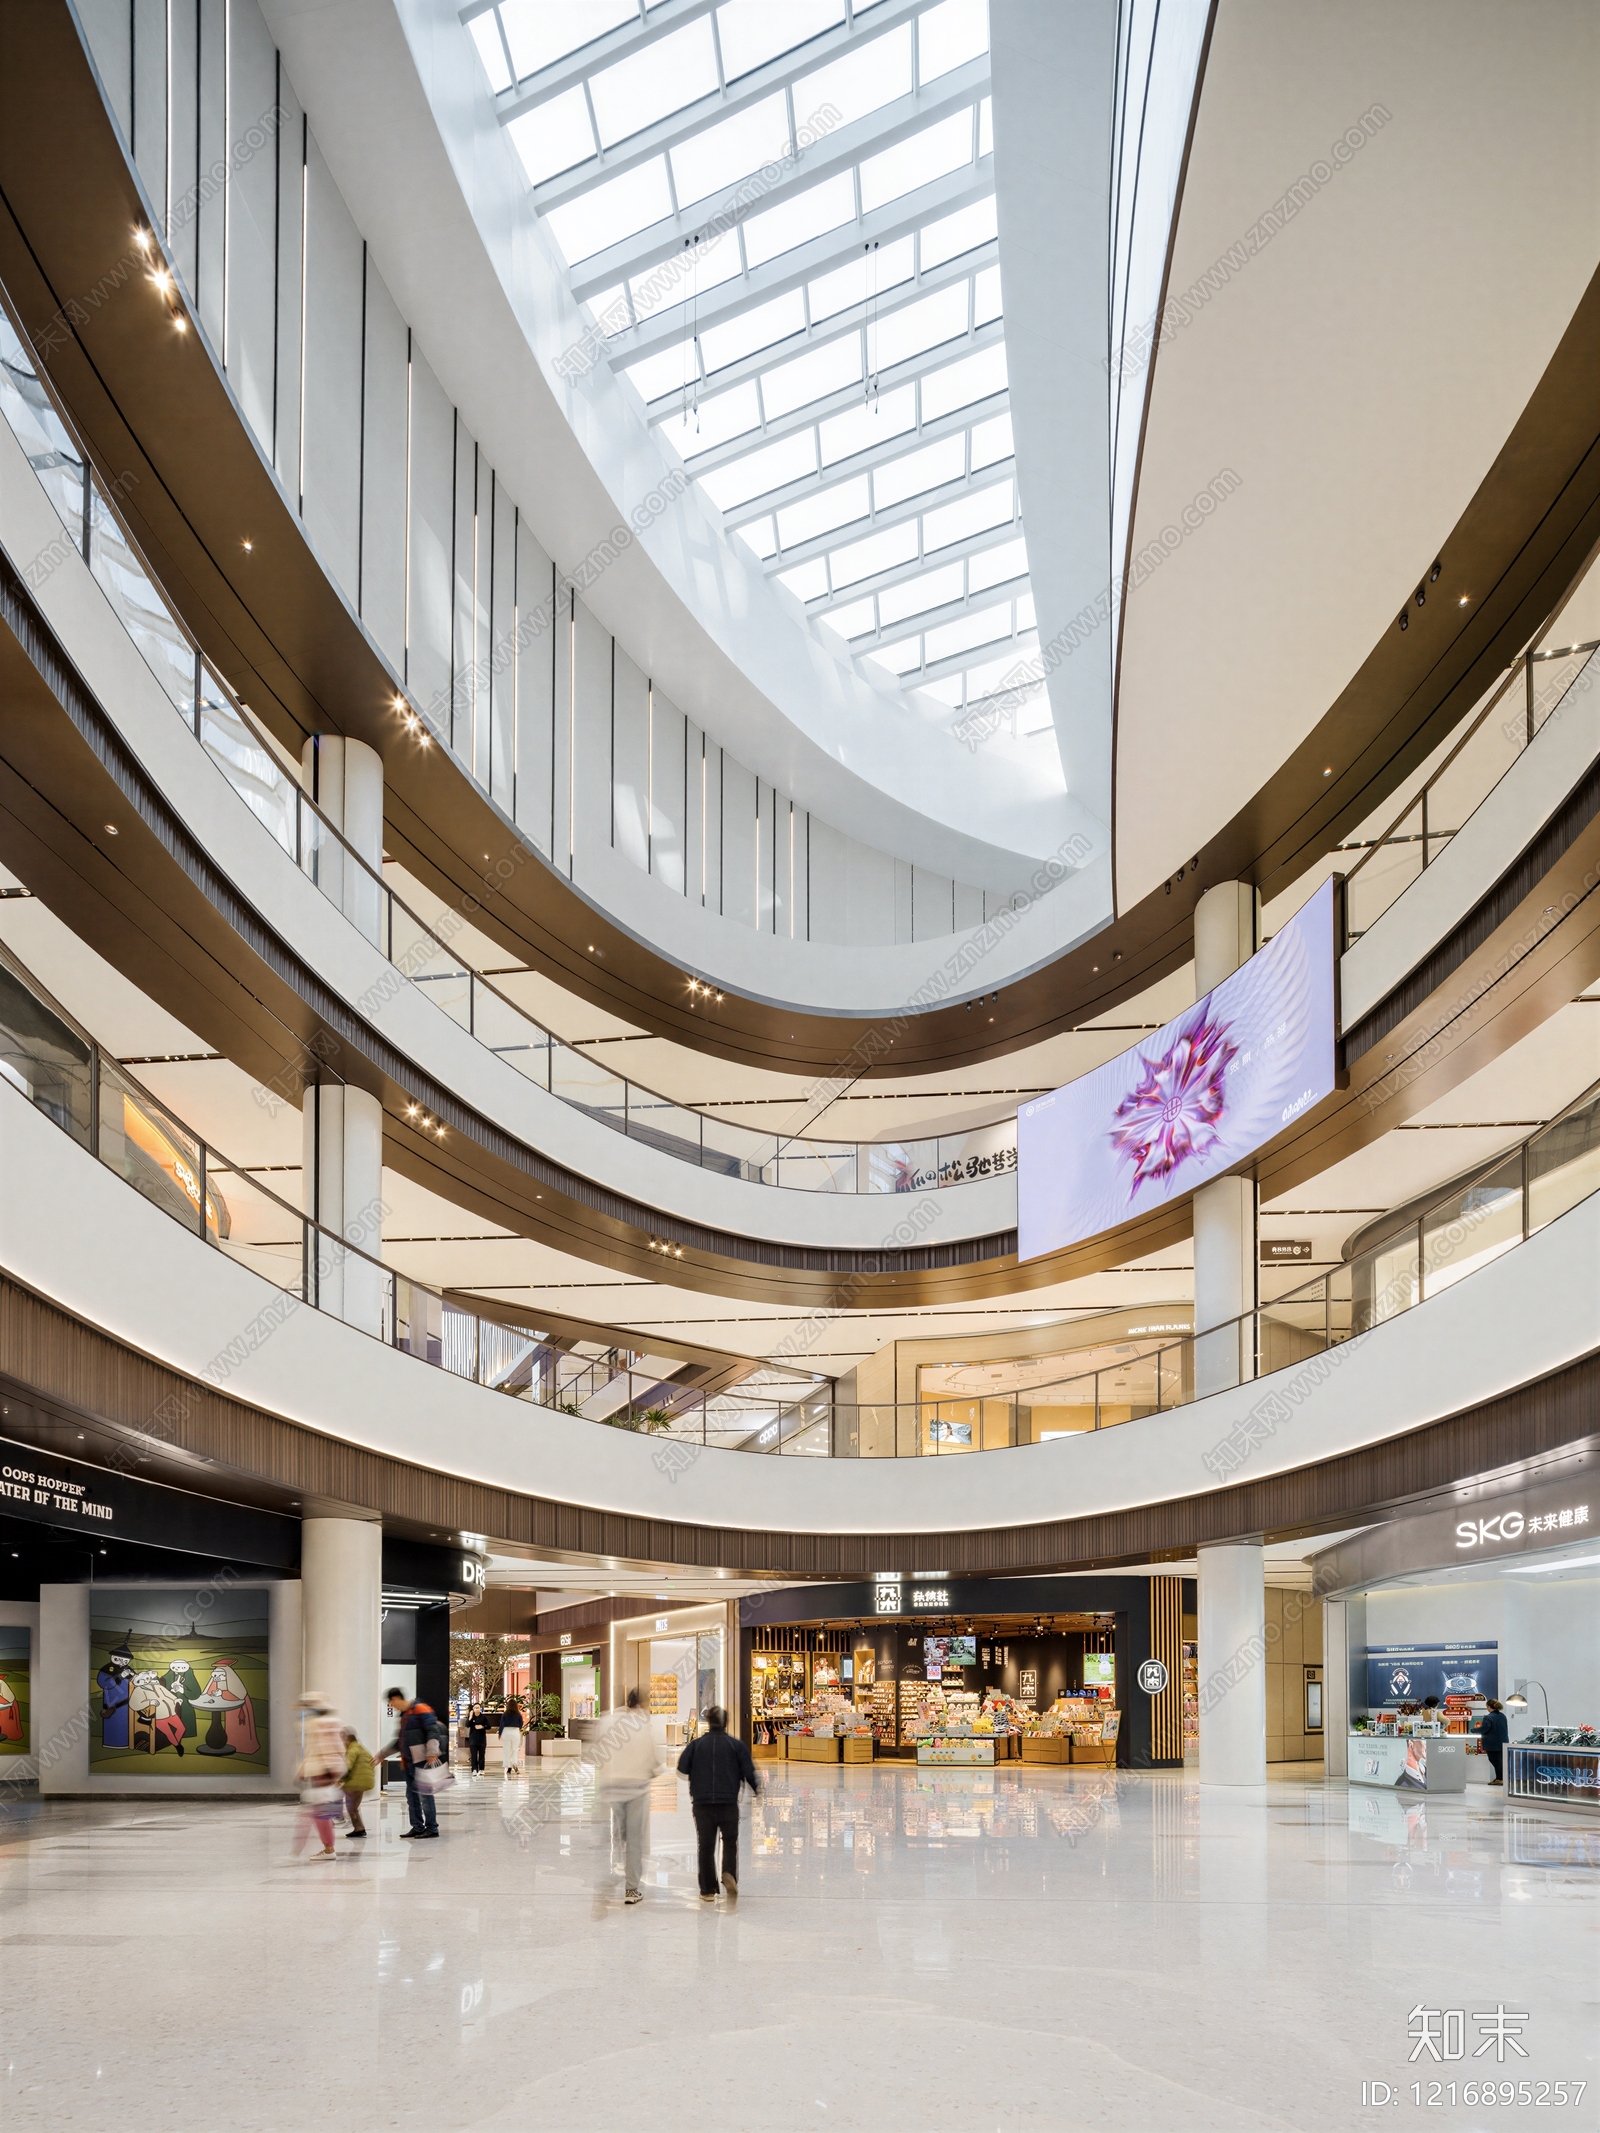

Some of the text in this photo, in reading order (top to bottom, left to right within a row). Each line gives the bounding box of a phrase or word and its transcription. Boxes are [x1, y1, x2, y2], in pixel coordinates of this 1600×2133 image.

[2, 1466, 35, 1484] OOPS
[33, 1489, 51, 1506] OF
[53, 1494, 79, 1513] THE
[81, 1501, 113, 1520] MIND
[1456, 1505, 1589, 1548] SKG 未来健康
